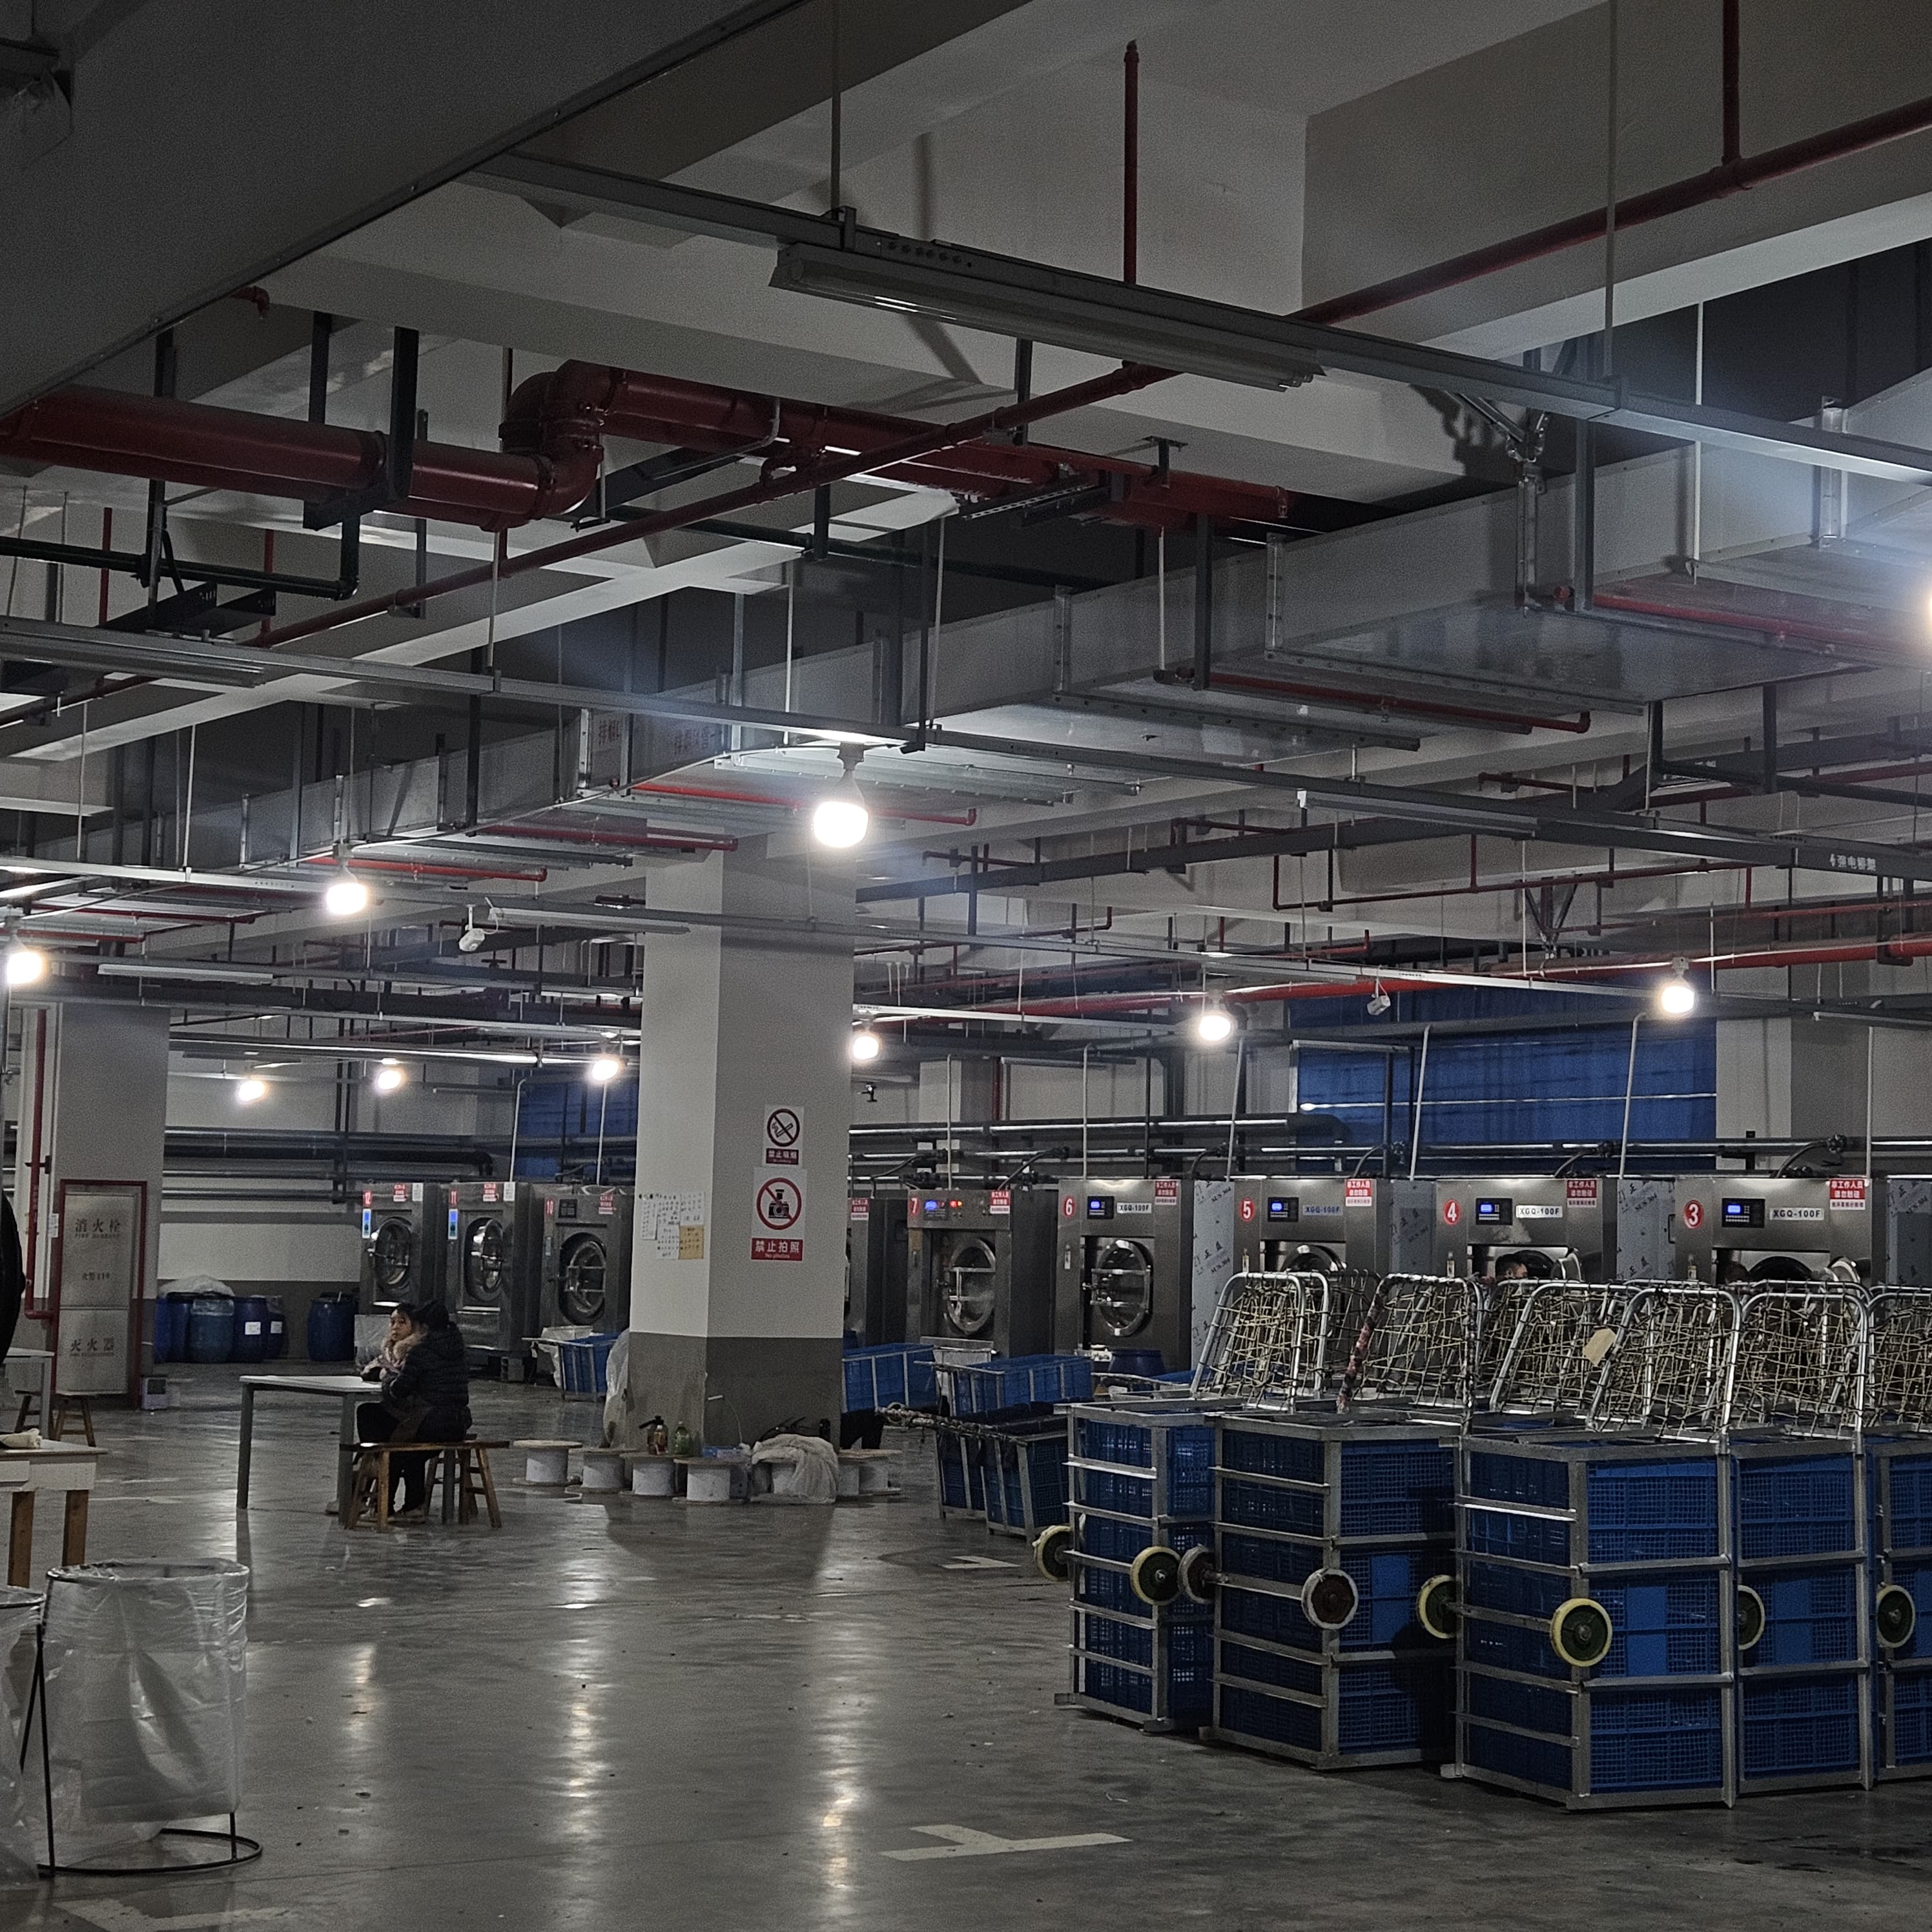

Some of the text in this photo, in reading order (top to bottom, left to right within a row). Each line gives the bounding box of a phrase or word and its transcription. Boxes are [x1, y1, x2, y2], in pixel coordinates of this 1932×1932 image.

[768, 1149, 797, 1159] 禁止吸烟
[451, 1191, 457, 1205] 11
[910, 1198, 920, 1213] 7
[546, 1200, 555, 1215] 10
[1065, 1200, 1074, 1216] 6
[1243, 1200, 1251, 1219] 5
[1447, 1204, 1457, 1220] 4
[1519, 1208, 1560, 1216] XGQ-100F
[1688, 1204, 1699, 1226] 3
[1773, 1209, 1821, 1218] XGQ-100F
[75, 1218, 121, 1233] 消火栓
[755, 1240, 800, 1253] 禁止拍照
